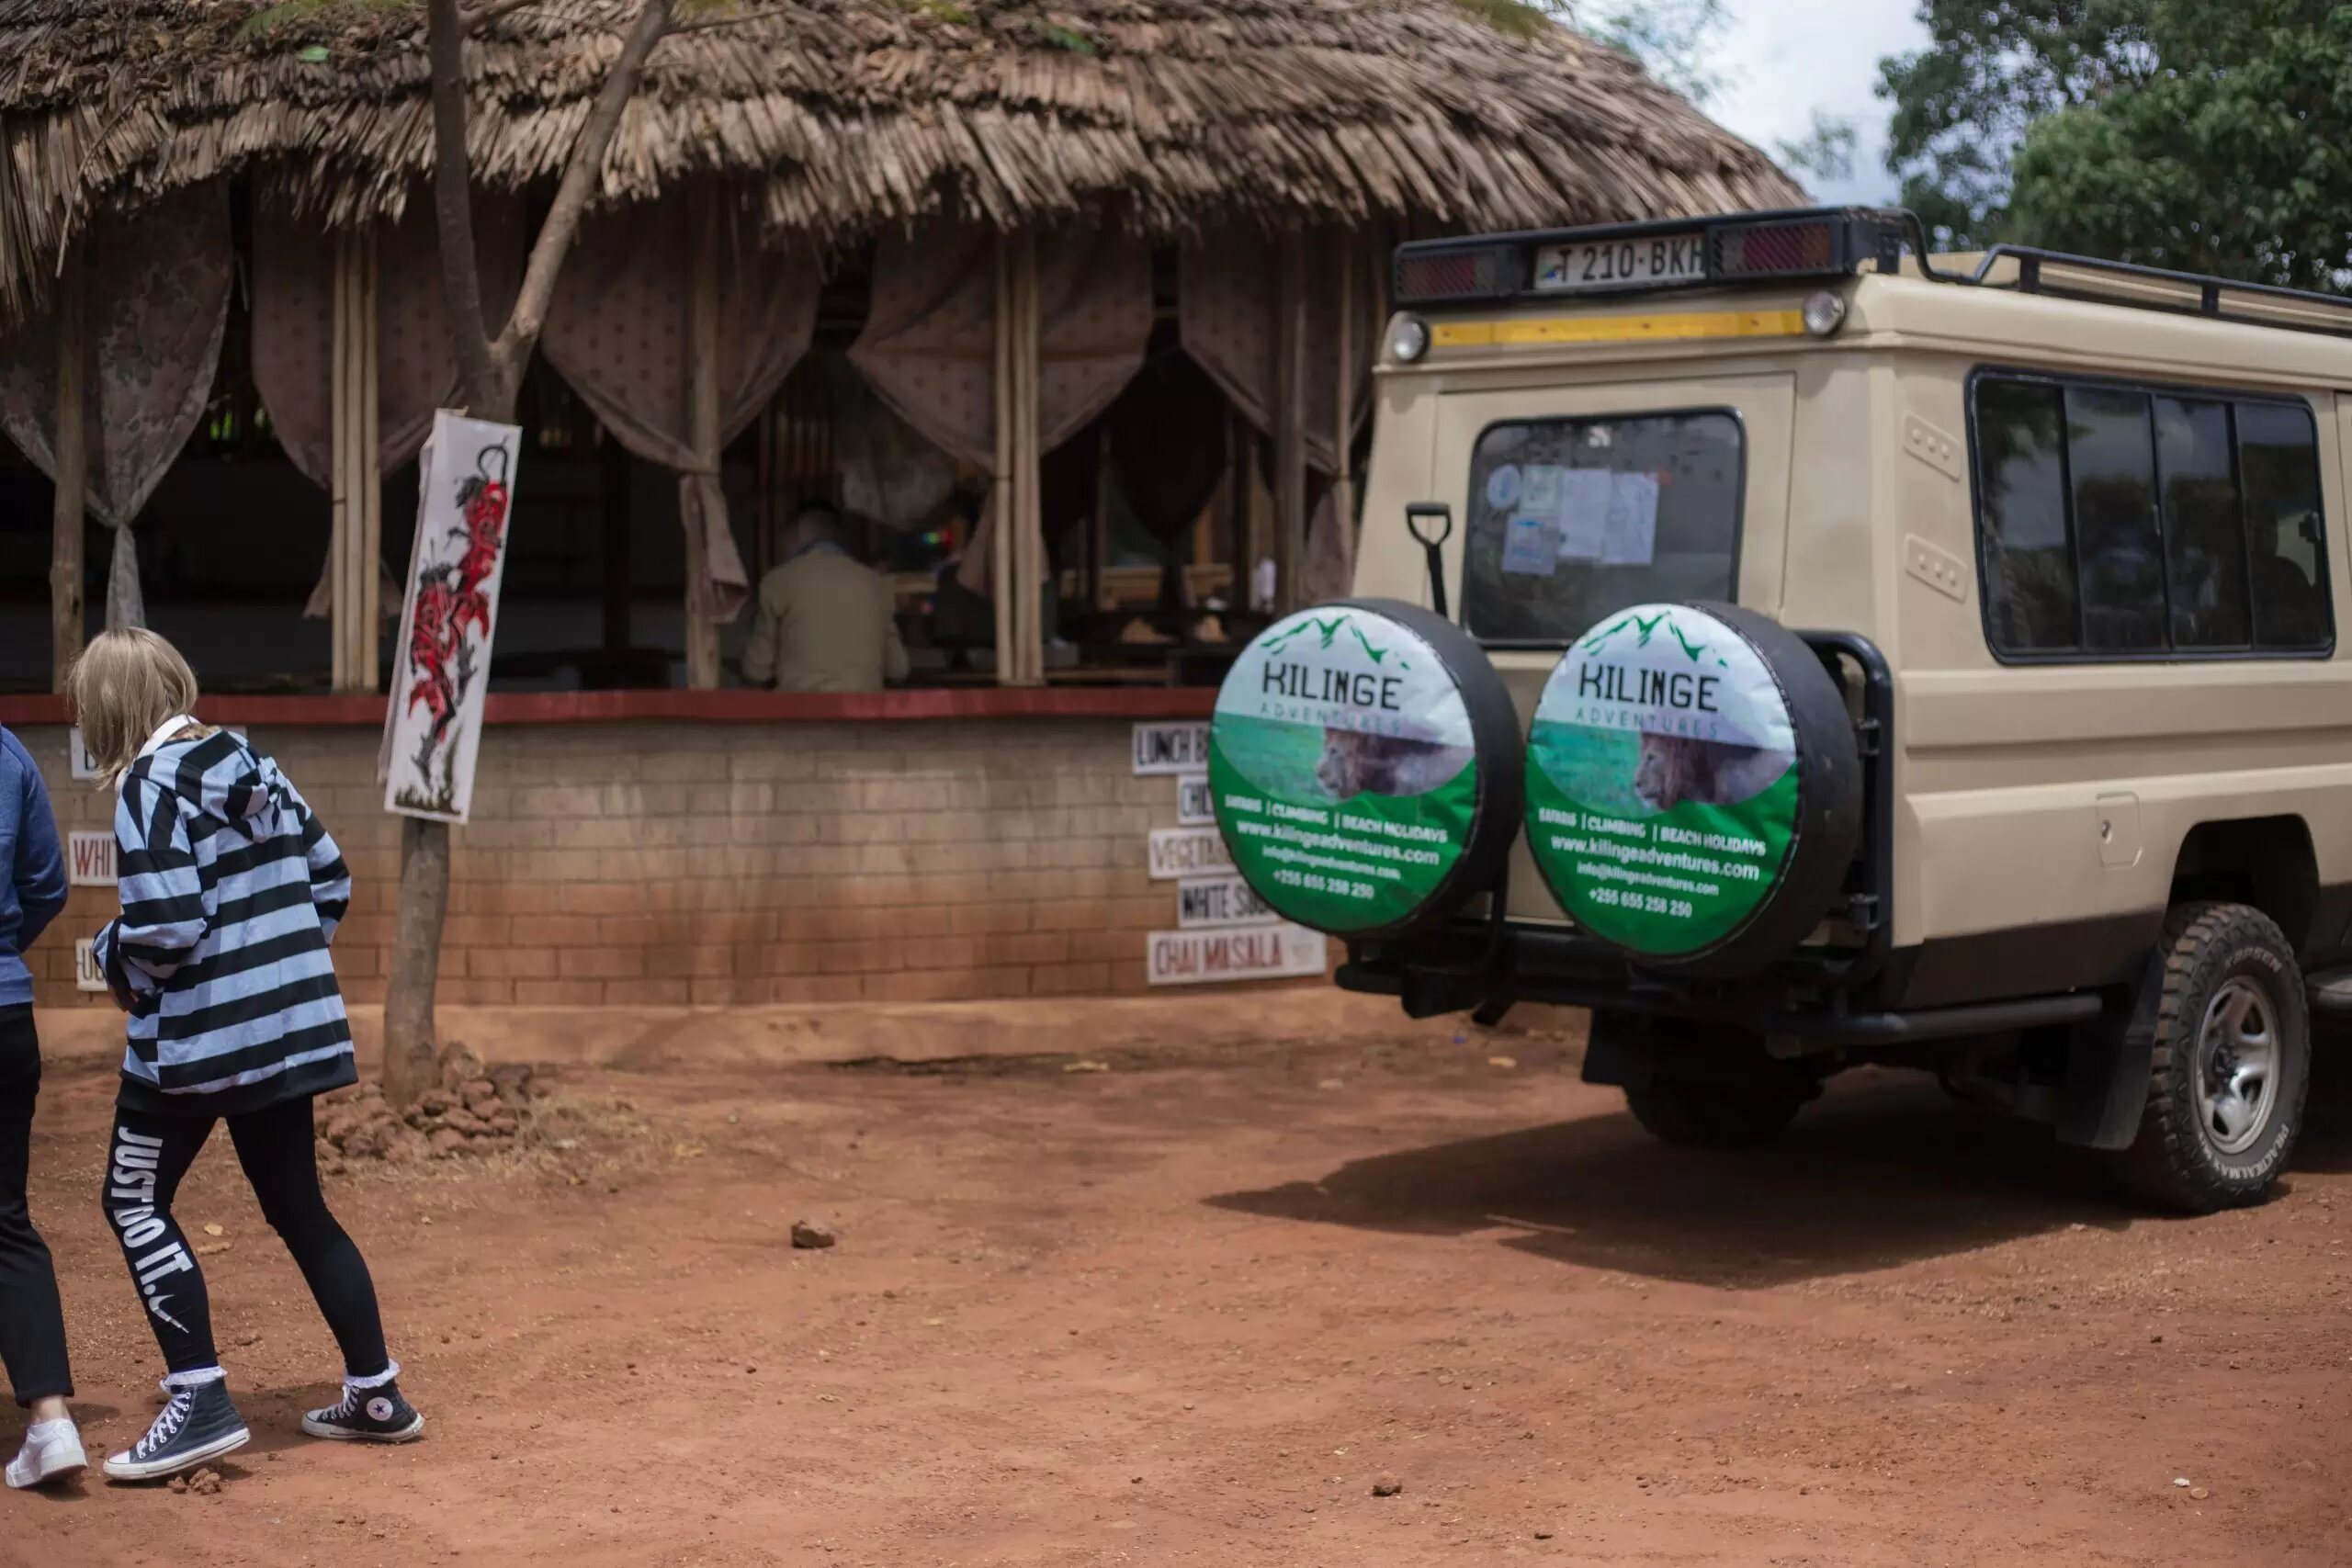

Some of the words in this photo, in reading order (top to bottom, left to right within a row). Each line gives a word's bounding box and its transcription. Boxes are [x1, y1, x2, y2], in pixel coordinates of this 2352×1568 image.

[1262, 660, 1404, 711] KILINGE
[1578, 661, 1721, 713] KILINGE
[1261, 701, 1402, 736] ADVENTURES
[1576, 707, 1719, 739] ADVENTURES
[1236, 820, 1440, 865] www.kilingeadventures.com
[1342, 814, 1383, 834] BEACH
[1384, 821, 1448, 843] HOLIDAYS
[1660, 826, 1702, 847] BEACH
[1703, 833, 1766, 857] HOLIDAYS
[74, 837, 117, 877] WHI
[1550, 835, 1760, 881] www.kilingeadventures.com
[1182, 883, 1229, 919] WHITE
[1155, 937, 1198, 976] CHAI
[1204, 932, 1283, 972] MASALA
[110, 1125, 164, 1203] JUST
[113, 1204, 166, 1248] DO
